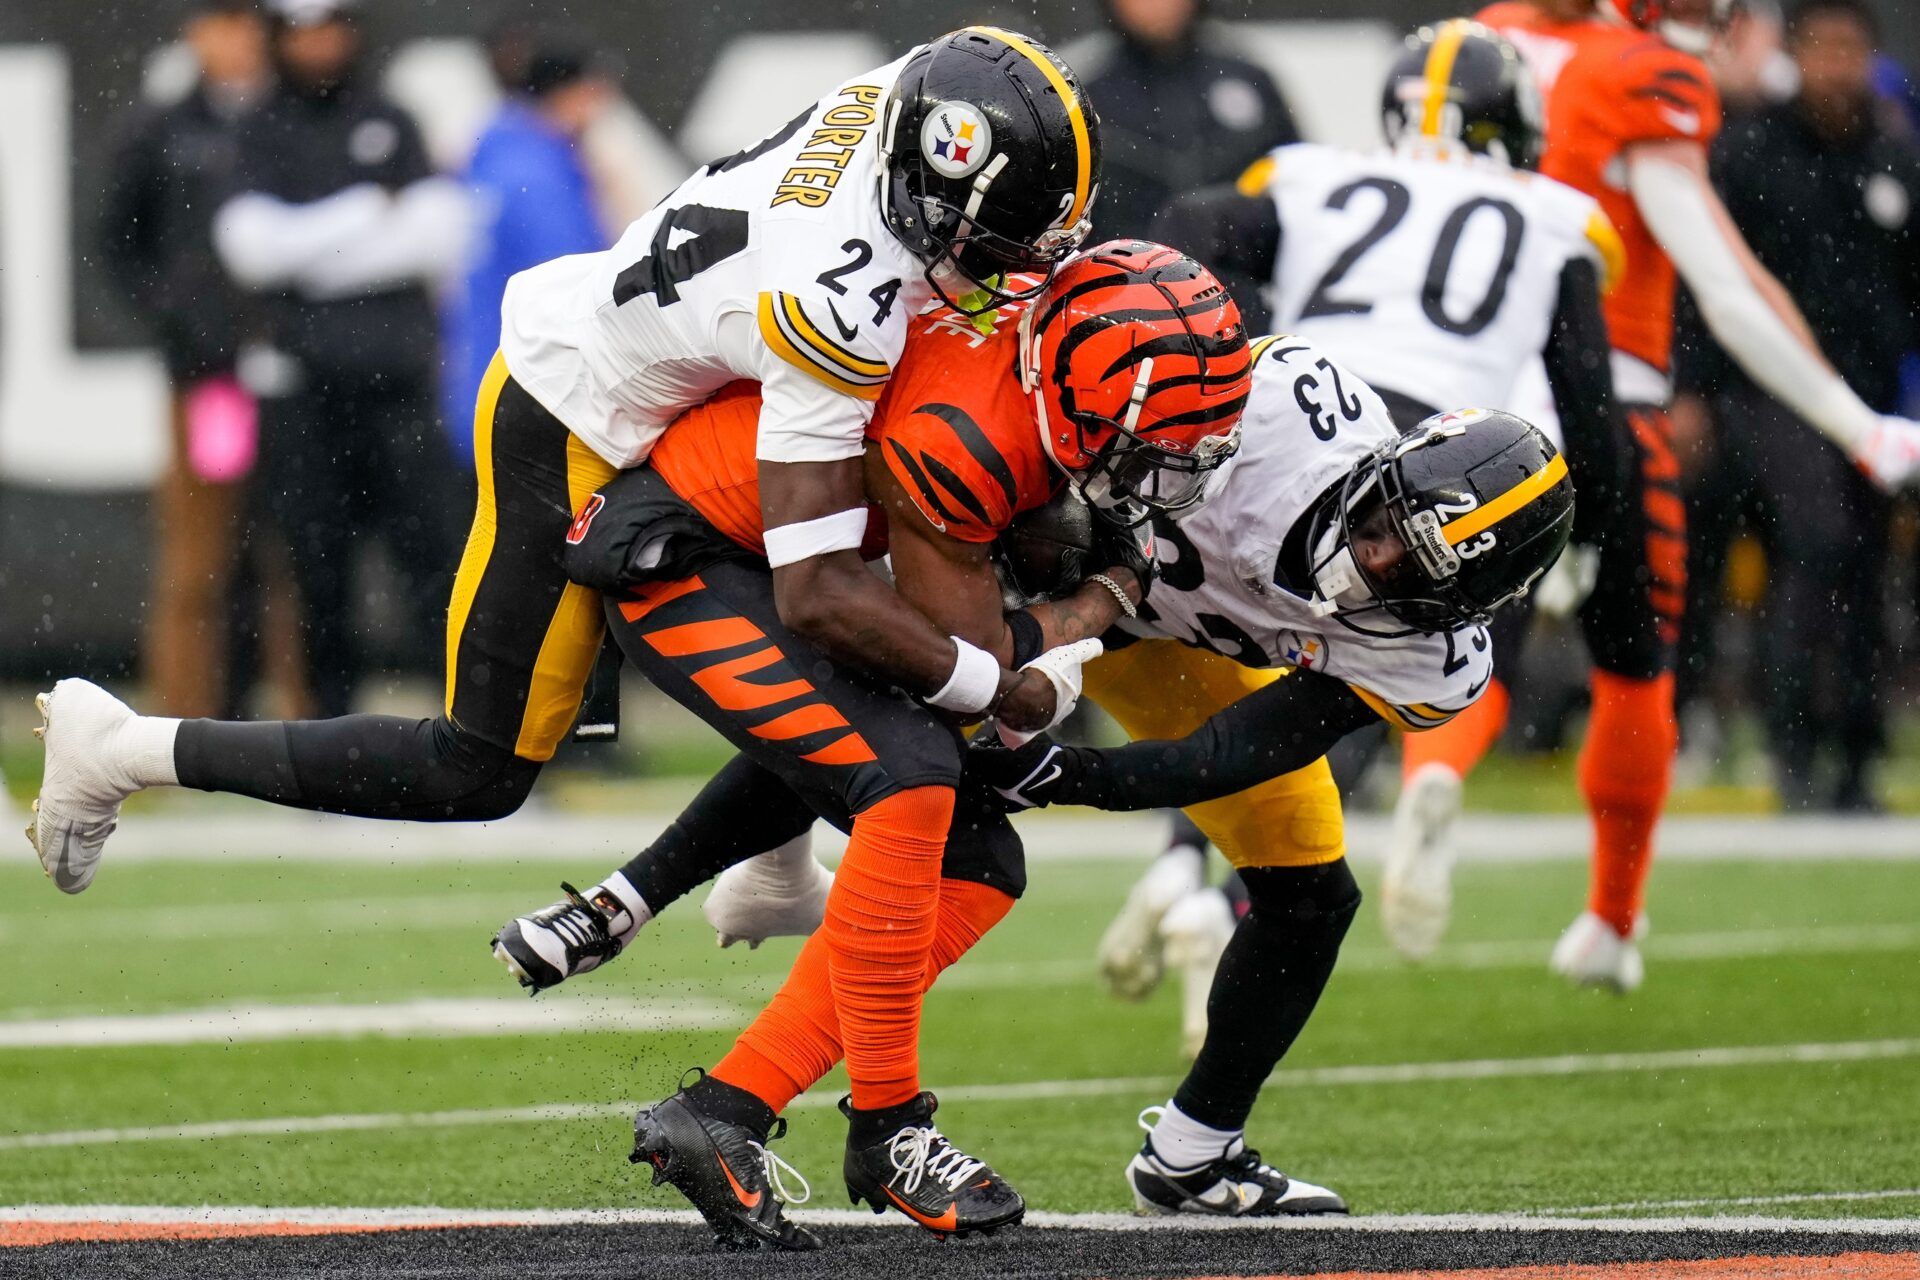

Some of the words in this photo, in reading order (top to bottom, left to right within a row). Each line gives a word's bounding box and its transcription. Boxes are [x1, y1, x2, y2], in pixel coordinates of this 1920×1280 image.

[769, 85, 884, 209] PORTER
[940, 112, 955, 138] Steelers
[815, 238, 902, 328] 24
[1298, 176, 1524, 337] 20
[1293, 357, 1362, 441] 23
[1424, 525, 1447, 560] Steelers
[1434, 492, 1497, 560] 23
